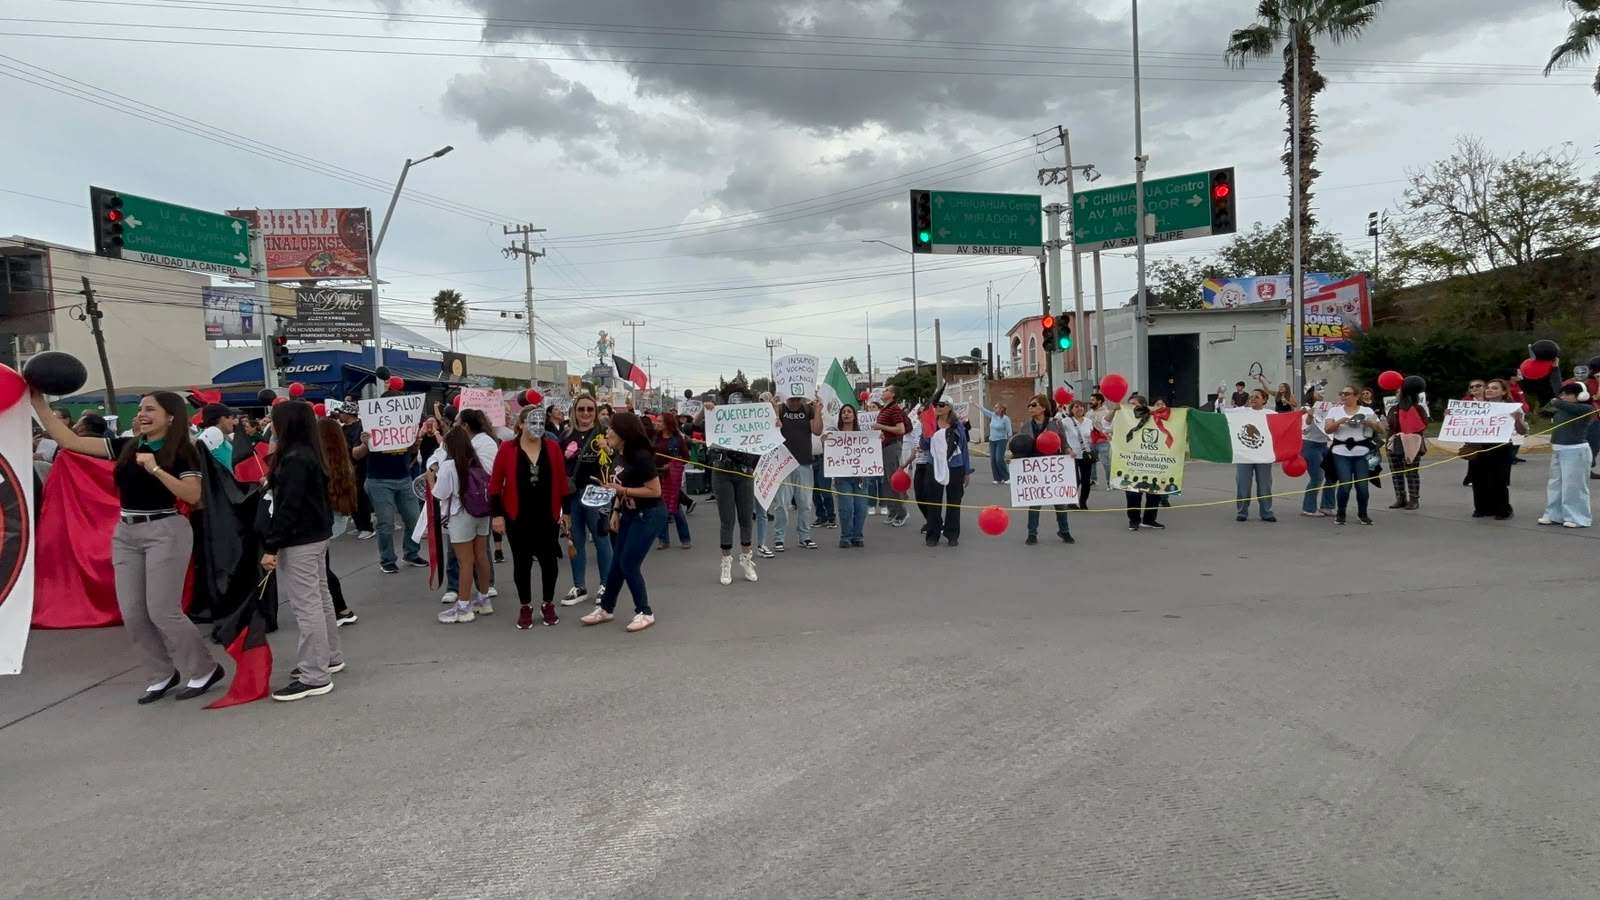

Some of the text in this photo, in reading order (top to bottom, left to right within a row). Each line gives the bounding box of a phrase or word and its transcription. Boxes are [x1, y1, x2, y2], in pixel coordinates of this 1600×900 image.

[1166, 181, 1205, 194] Centro
[259, 208, 338, 235] BIRRIA
[265, 236, 345, 251] INALOENSE
[972, 246, 991, 255] SAN
[993, 246, 1023, 255] FELIPE
[140, 253, 239, 275] VIALIDAD LA CANTERA
[297, 364, 330, 373] LIGHT
[369, 397, 421, 415] LA SALUD
[716, 407, 770, 421] QUEREMOS
[783, 412, 806, 420] AERO
[379, 415, 414, 427] ES UN
[714, 421, 771, 434] EL SALARIO
[1490, 416, 1508, 426] ES
[1446, 428, 1461, 437] TU
[718, 434, 764, 446] DE ZOE
[827, 432, 869, 447] Salario
[843, 446, 875, 458] Digno
[1140, 443, 1158, 451] IMSS
[827, 456, 860, 467] Retiro
[852, 460, 884, 475] Justo
[1023, 456, 1065, 473] BASES
[1017, 473, 1065, 486] PARA LOS
[1017, 485, 1078, 502] HEROES COVID
